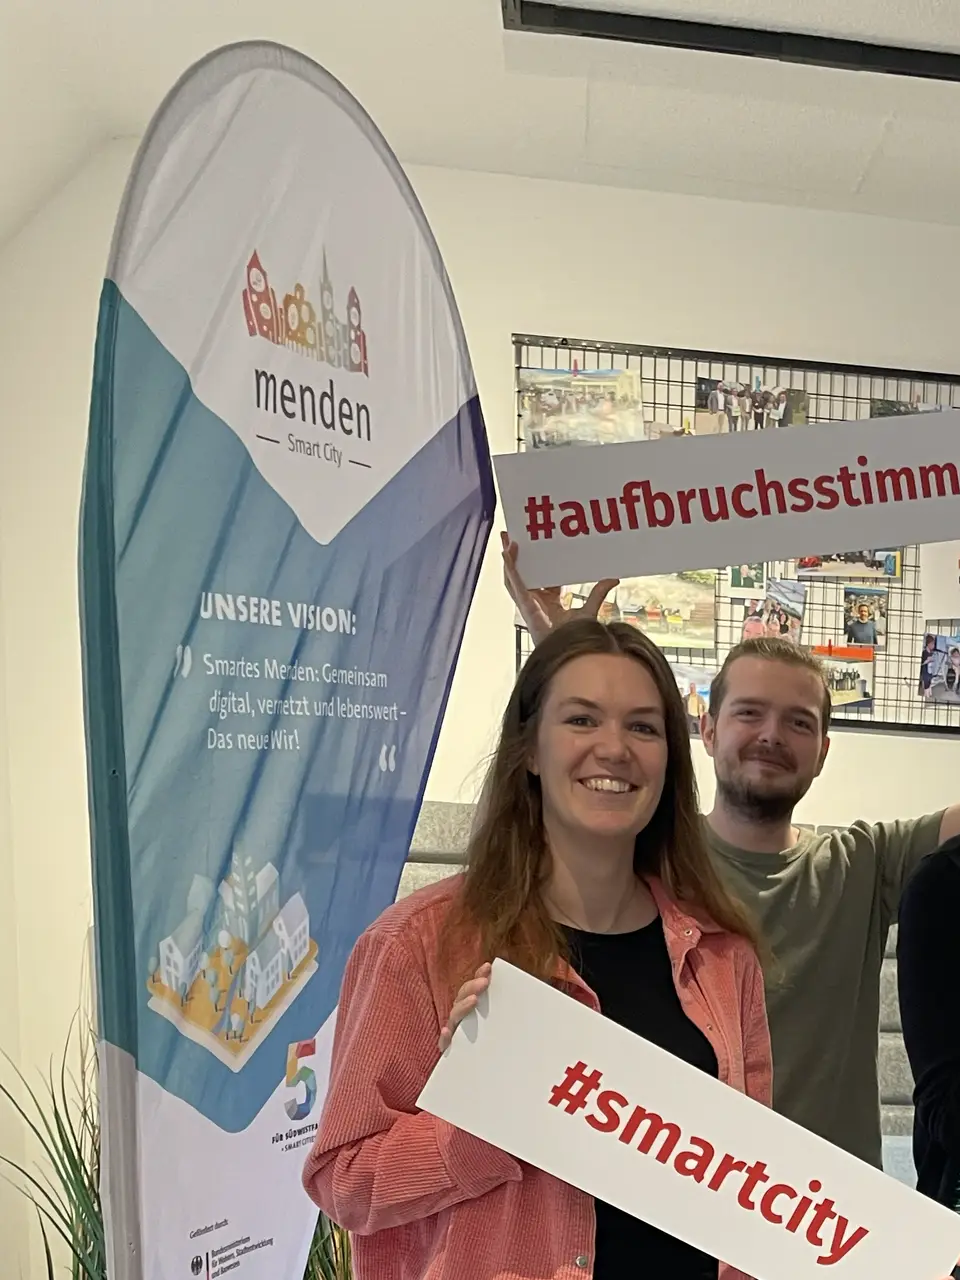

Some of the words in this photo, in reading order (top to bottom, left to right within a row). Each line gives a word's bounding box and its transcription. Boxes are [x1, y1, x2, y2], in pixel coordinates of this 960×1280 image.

[254, 368, 371, 441] menden
[287, 433, 321, 459] Smart
[323, 443, 342, 468] City
[200, 592, 282, 627] UNSERE
[287, 602, 357, 635] VISION:
[203, 653, 260, 679] Smartes
[264, 658, 320, 682] Menden:
[322, 663, 388, 688] Gemeinsam
[209, 690, 256, 719] digital,
[256, 696, 311, 717] vernetzt
[313, 697, 334, 718] und
[207, 728, 233, 750] Das
[237, 732, 269, 750] neue
[270, 729, 301, 750] Wir!
[271, 1132, 283, 1144] FÜR
[284, 1123, 319, 1142] SÜDWESTFA
[547, 1060, 869, 1266] #smartcity
